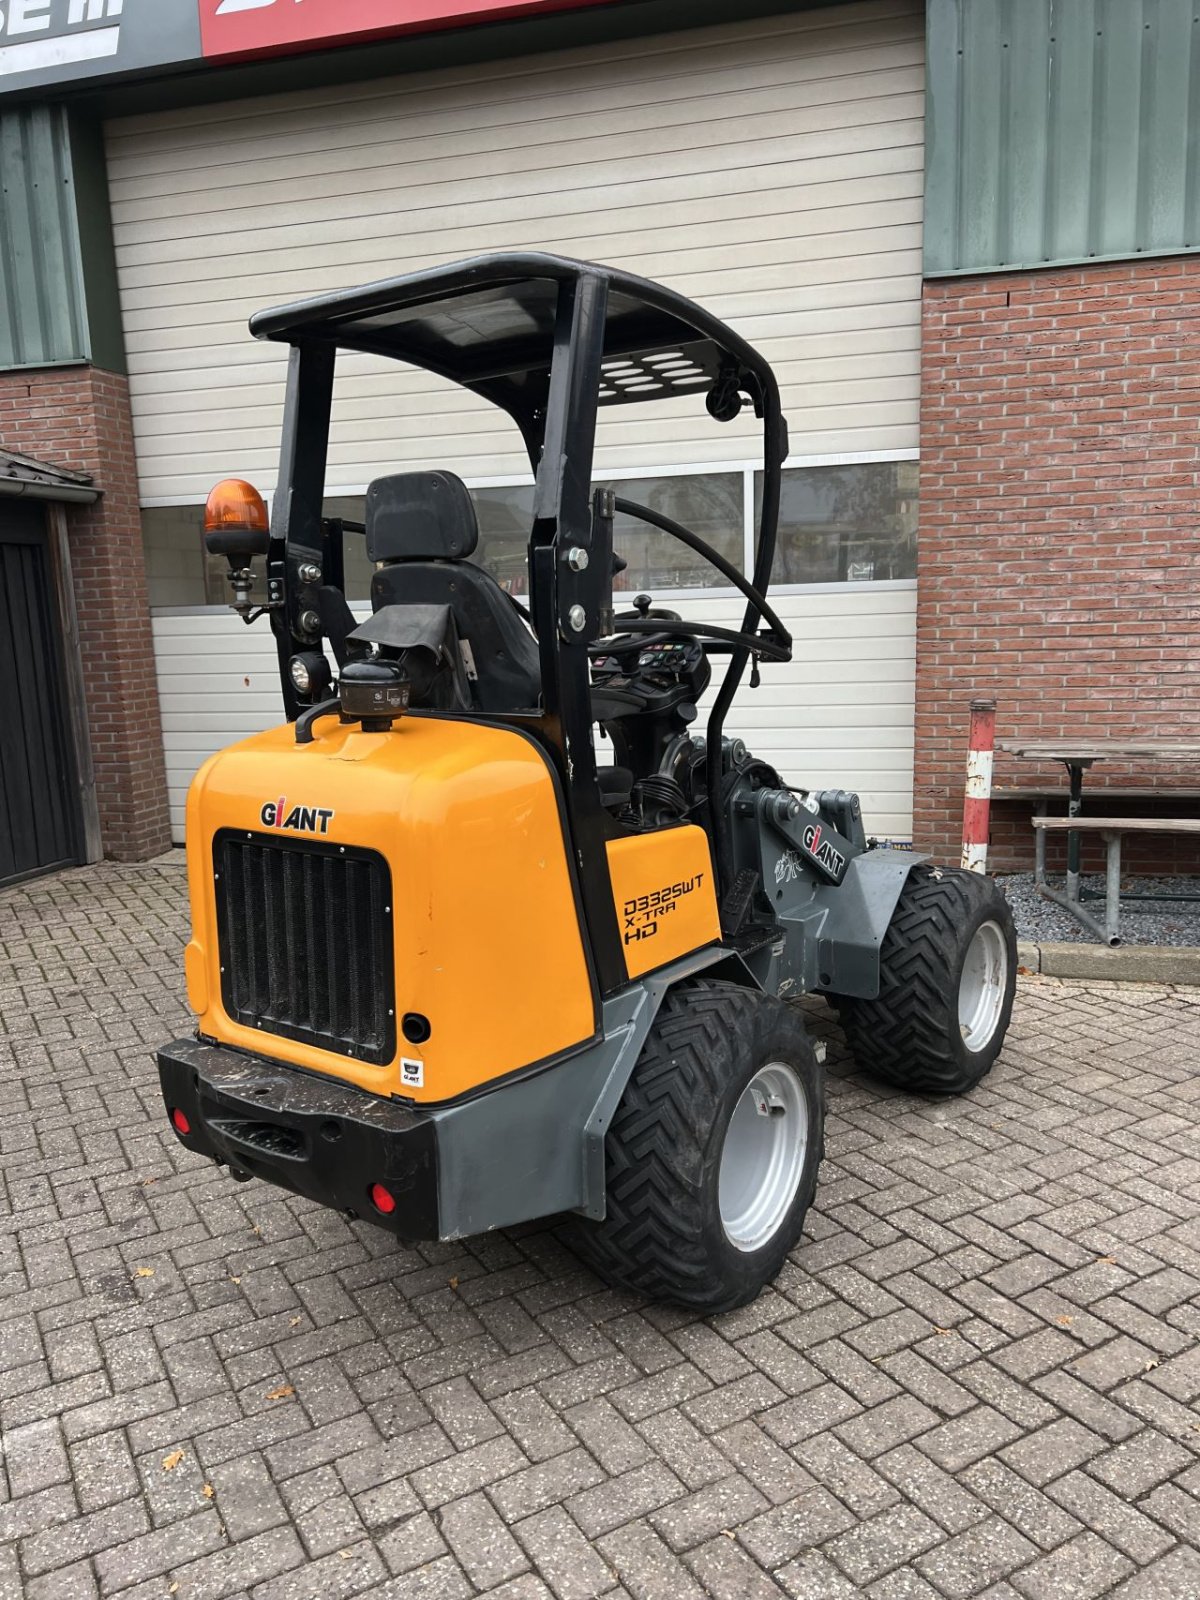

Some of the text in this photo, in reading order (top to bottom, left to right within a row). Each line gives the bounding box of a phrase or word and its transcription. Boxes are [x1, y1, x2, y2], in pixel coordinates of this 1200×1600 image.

[624, 873, 704, 917] D332SWT
[625, 901, 676, 929] X-TRA
[624, 921, 657, 945] HD
